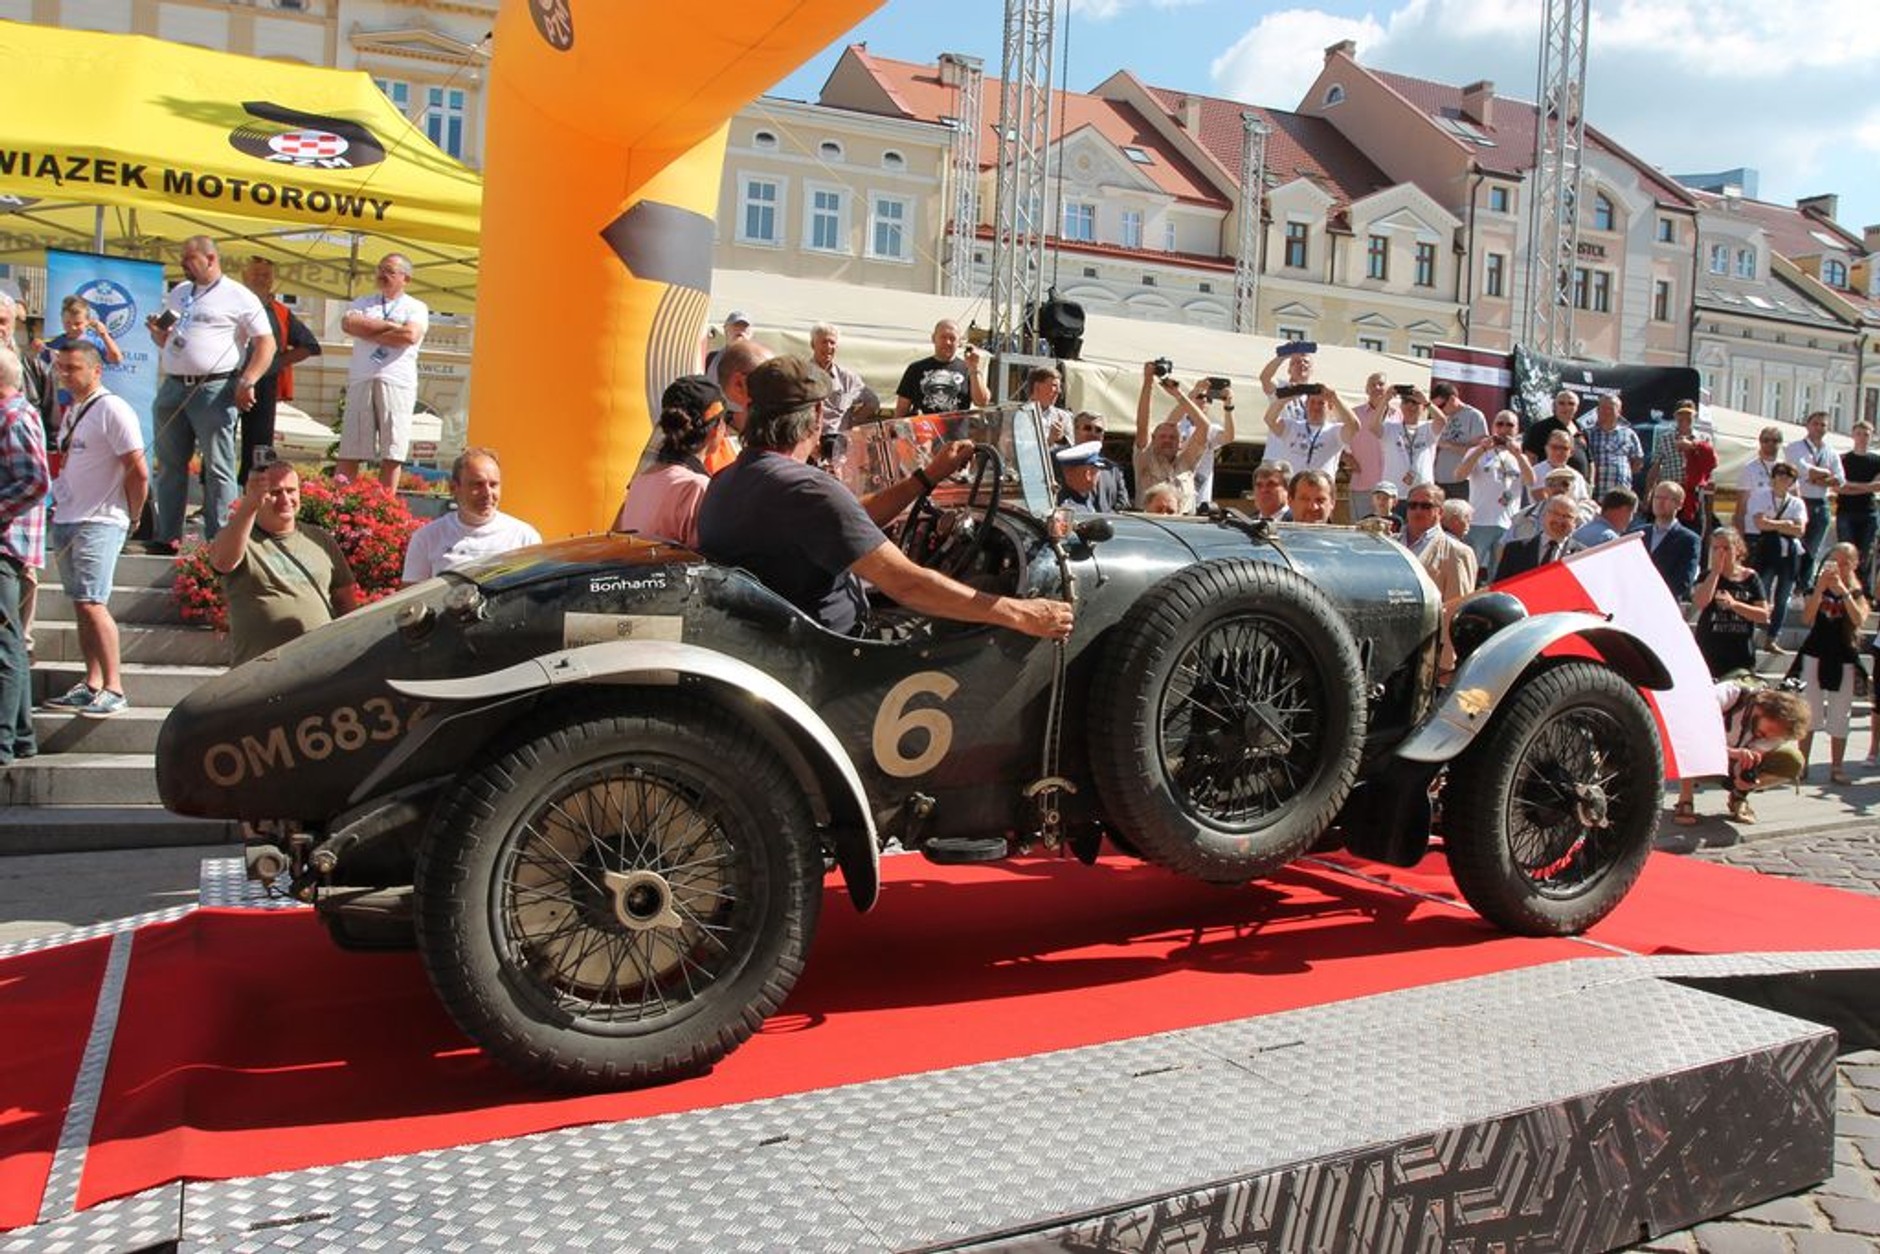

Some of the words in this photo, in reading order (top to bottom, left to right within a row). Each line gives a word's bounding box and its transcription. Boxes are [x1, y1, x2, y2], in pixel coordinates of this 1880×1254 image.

[164, 169, 393, 221] MOTOROWY
[589, 579, 667, 593] Bonhams
[872, 670, 960, 778] 6
